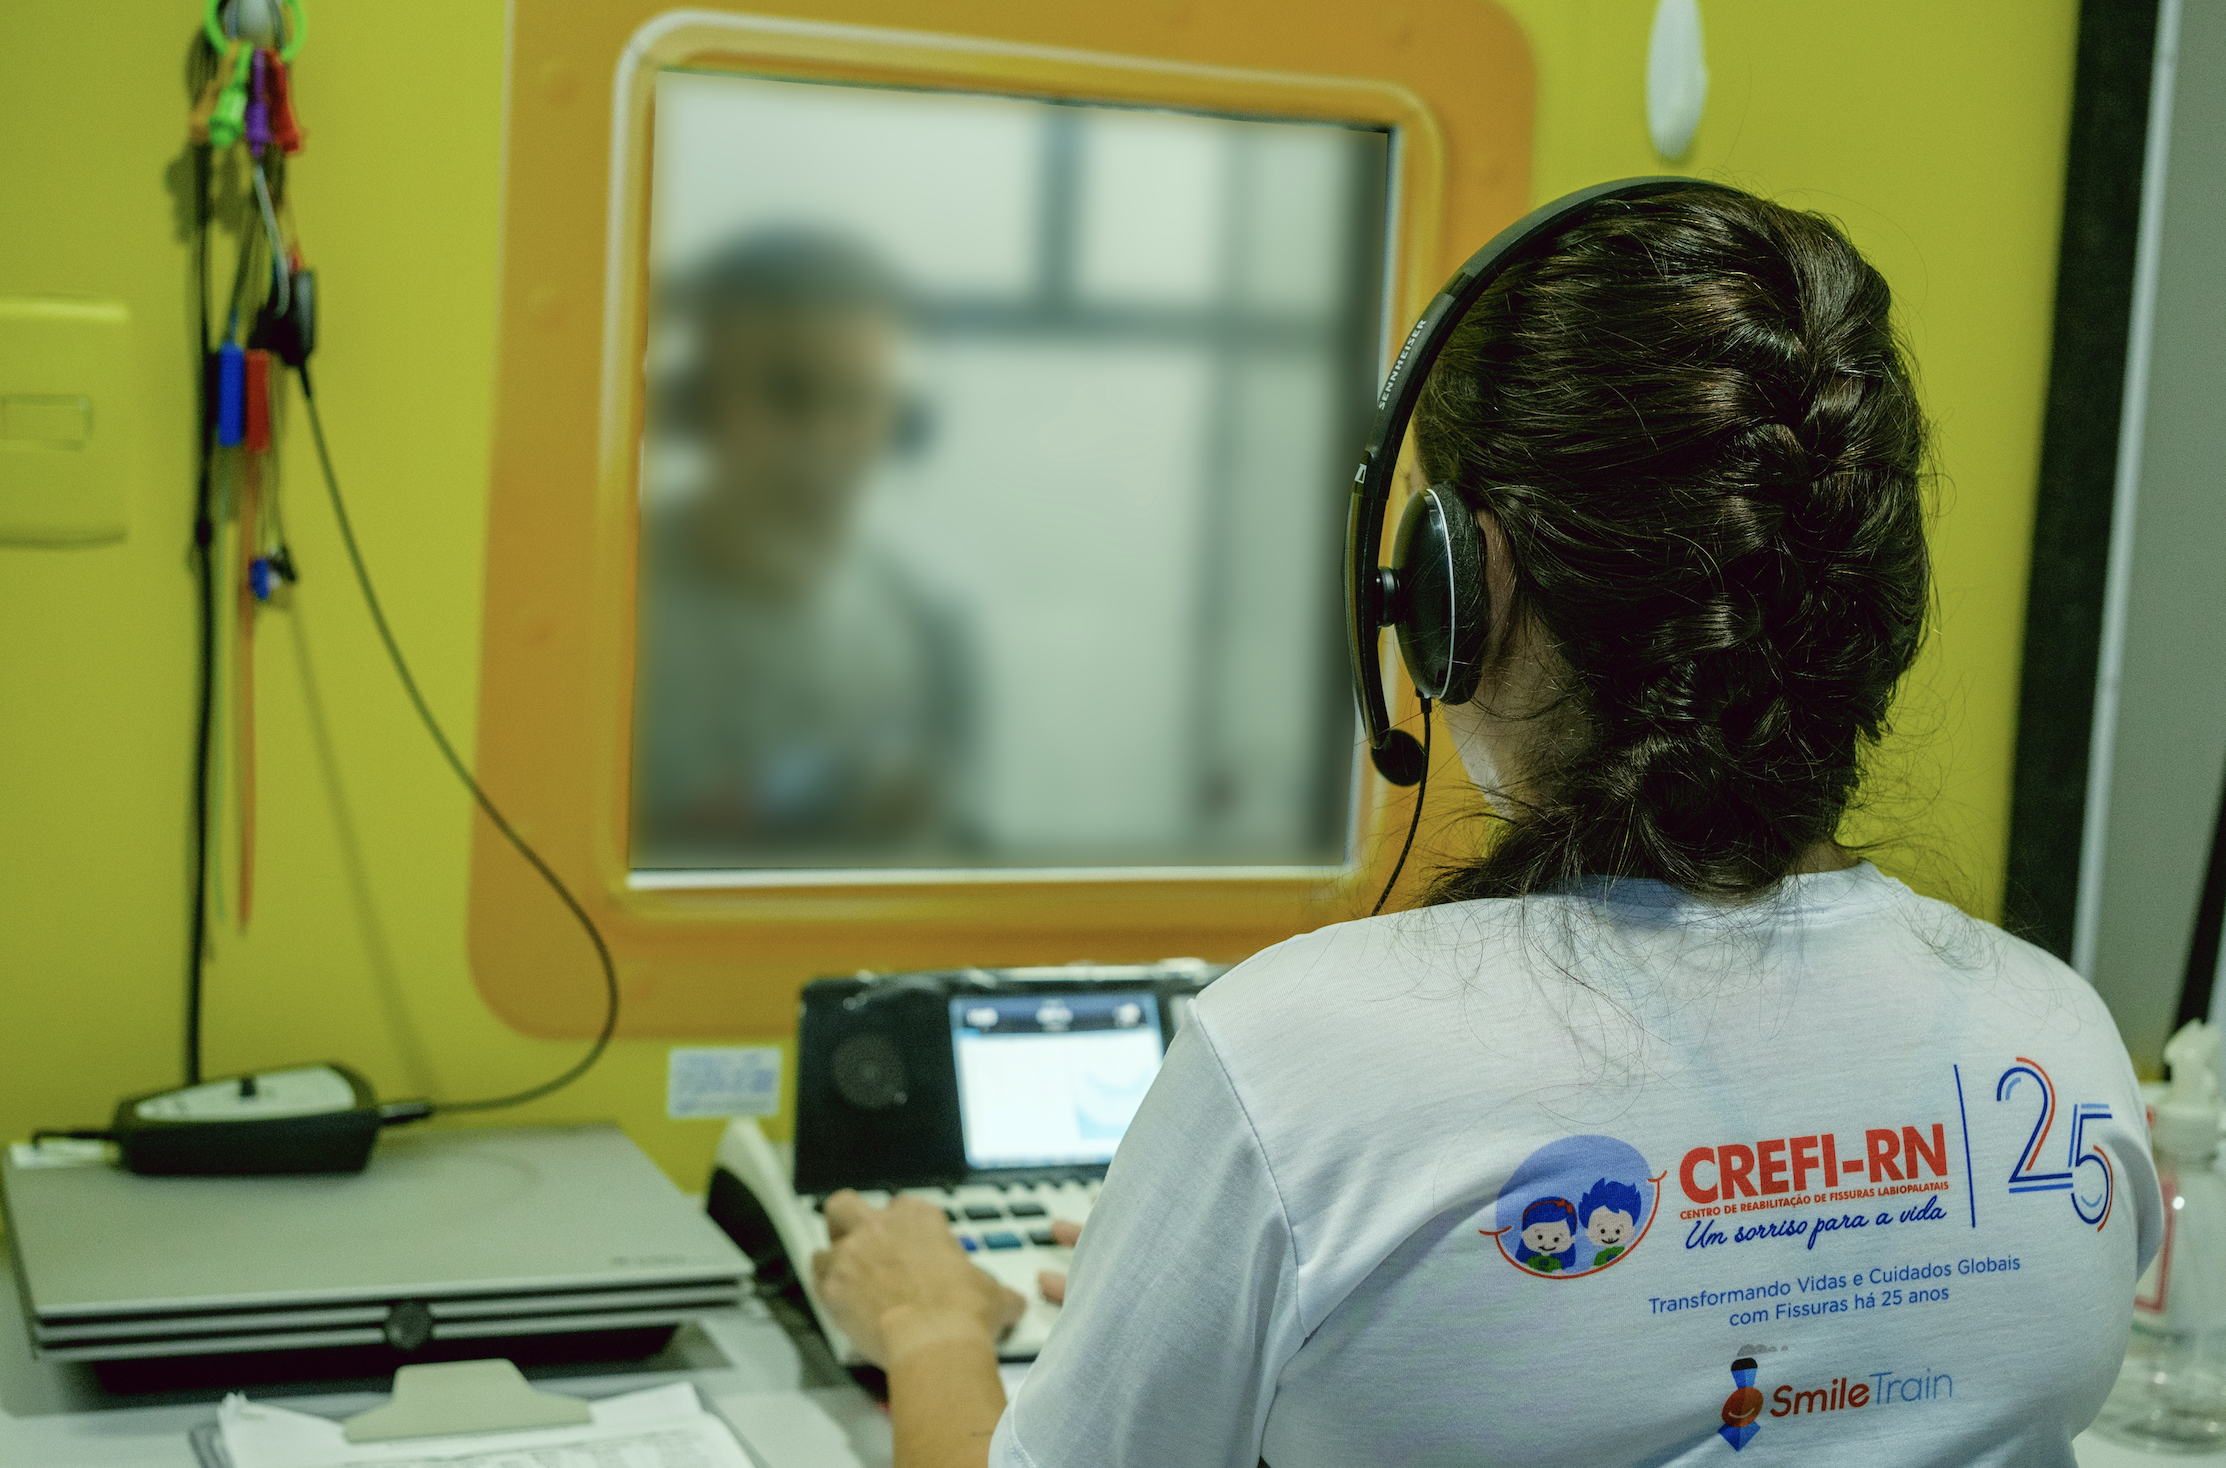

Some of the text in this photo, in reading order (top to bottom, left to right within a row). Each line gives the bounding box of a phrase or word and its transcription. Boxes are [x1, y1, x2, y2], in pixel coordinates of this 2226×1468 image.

[1378, 318, 1427, 411] SENNHEISER
[1679, 1123, 1948, 1205] CREFI-RN
[1996, 1056, 2114, 1232] 25
[1679, 1181, 1949, 1220] CENTRO DE REABILITAÇÃO DE FISSURAS LABIOPALATAIS
[1685, 1194, 1947, 1250] Um sorriso para a vida
[1649, 1254, 2021, 1314] Transformando Vidas e Cuidados Globais
[1729, 1287, 1950, 1327] com Fissuras há 25 anos
[1770, 1367, 1953, 1418] SmileTrain
